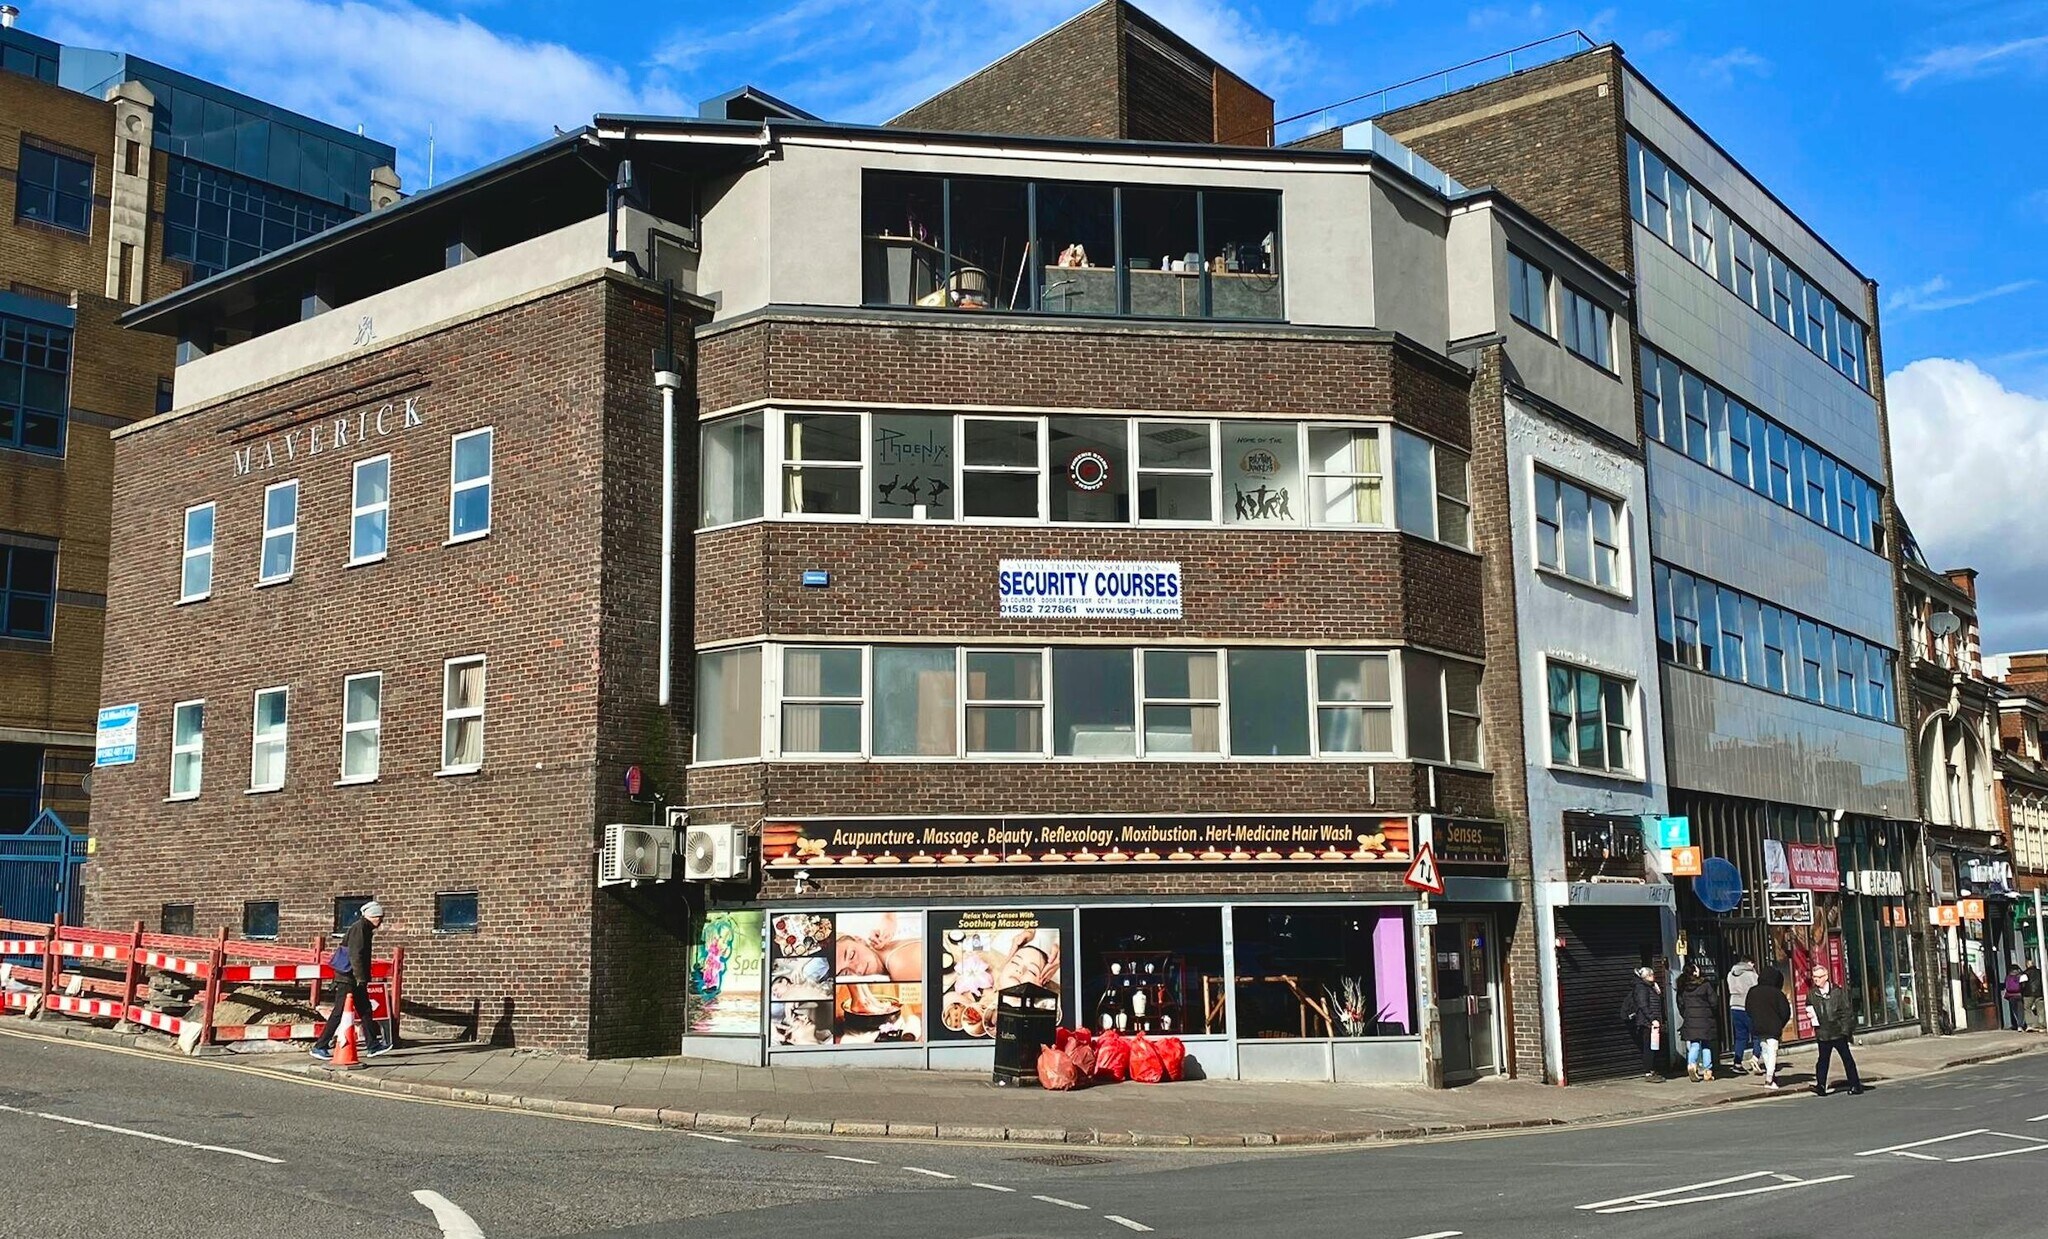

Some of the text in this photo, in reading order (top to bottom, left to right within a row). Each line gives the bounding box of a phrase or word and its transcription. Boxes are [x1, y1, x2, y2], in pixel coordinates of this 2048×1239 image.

[233, 396, 422, 478] MAVERICK
[1105, 564, 1159, 572] SOLUTIONS
[1000, 571, 1178, 597] SECURITY COURSES
[1000, 605, 1179, 616] 01582 727861 www.vsg-uk.com
[833, 829, 915, 849] Acupuncture
[923, 828, 979, 848] Massage
[987, 827, 1033, 847] Beauty
[1041, 825, 1113, 847] Reflexology
[1121, 825, 1197, 842] Moxibustion
[1291, 825, 1319, 841] Hair
[1320, 824, 1352, 841] Wash
[1447, 822, 1482, 843] Senses
[1570, 886, 1582, 901] EAT
[958, 919, 1039, 929] Soothing Massages
[733, 955, 759, 975] Spa
